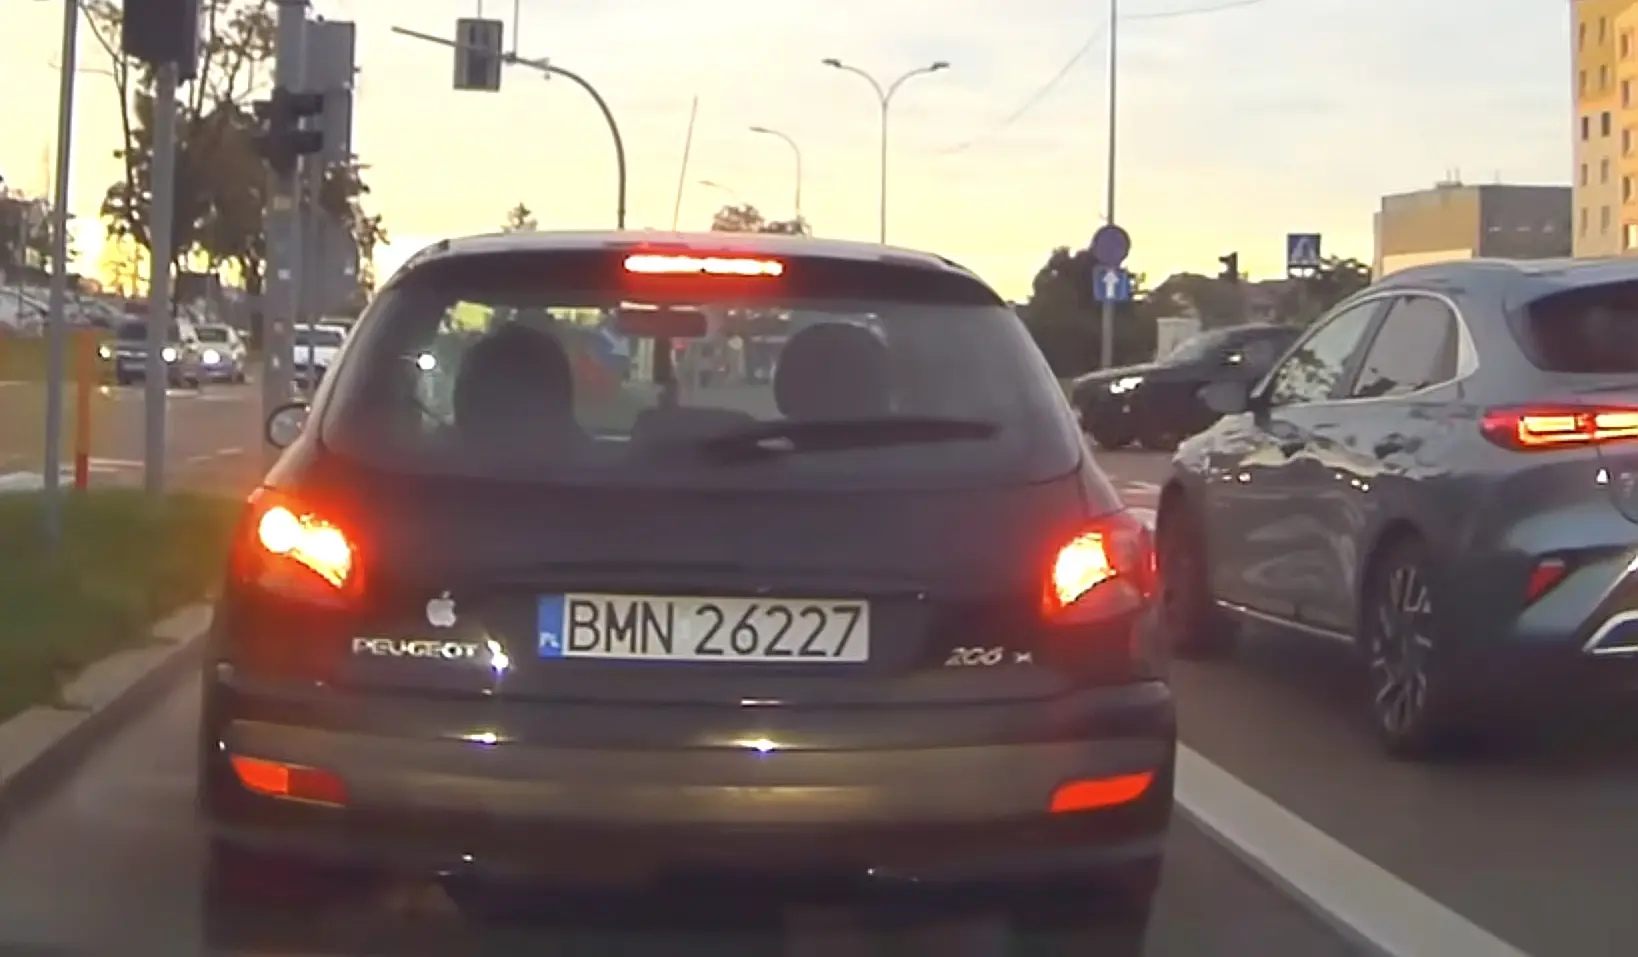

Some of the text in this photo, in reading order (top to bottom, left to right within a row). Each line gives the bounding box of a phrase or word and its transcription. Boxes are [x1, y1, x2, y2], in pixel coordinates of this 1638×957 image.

[568, 600, 862, 657] BMN 26227
[352, 637, 478, 658] PEUGEOT
[944, 646, 1004, 666] 206
